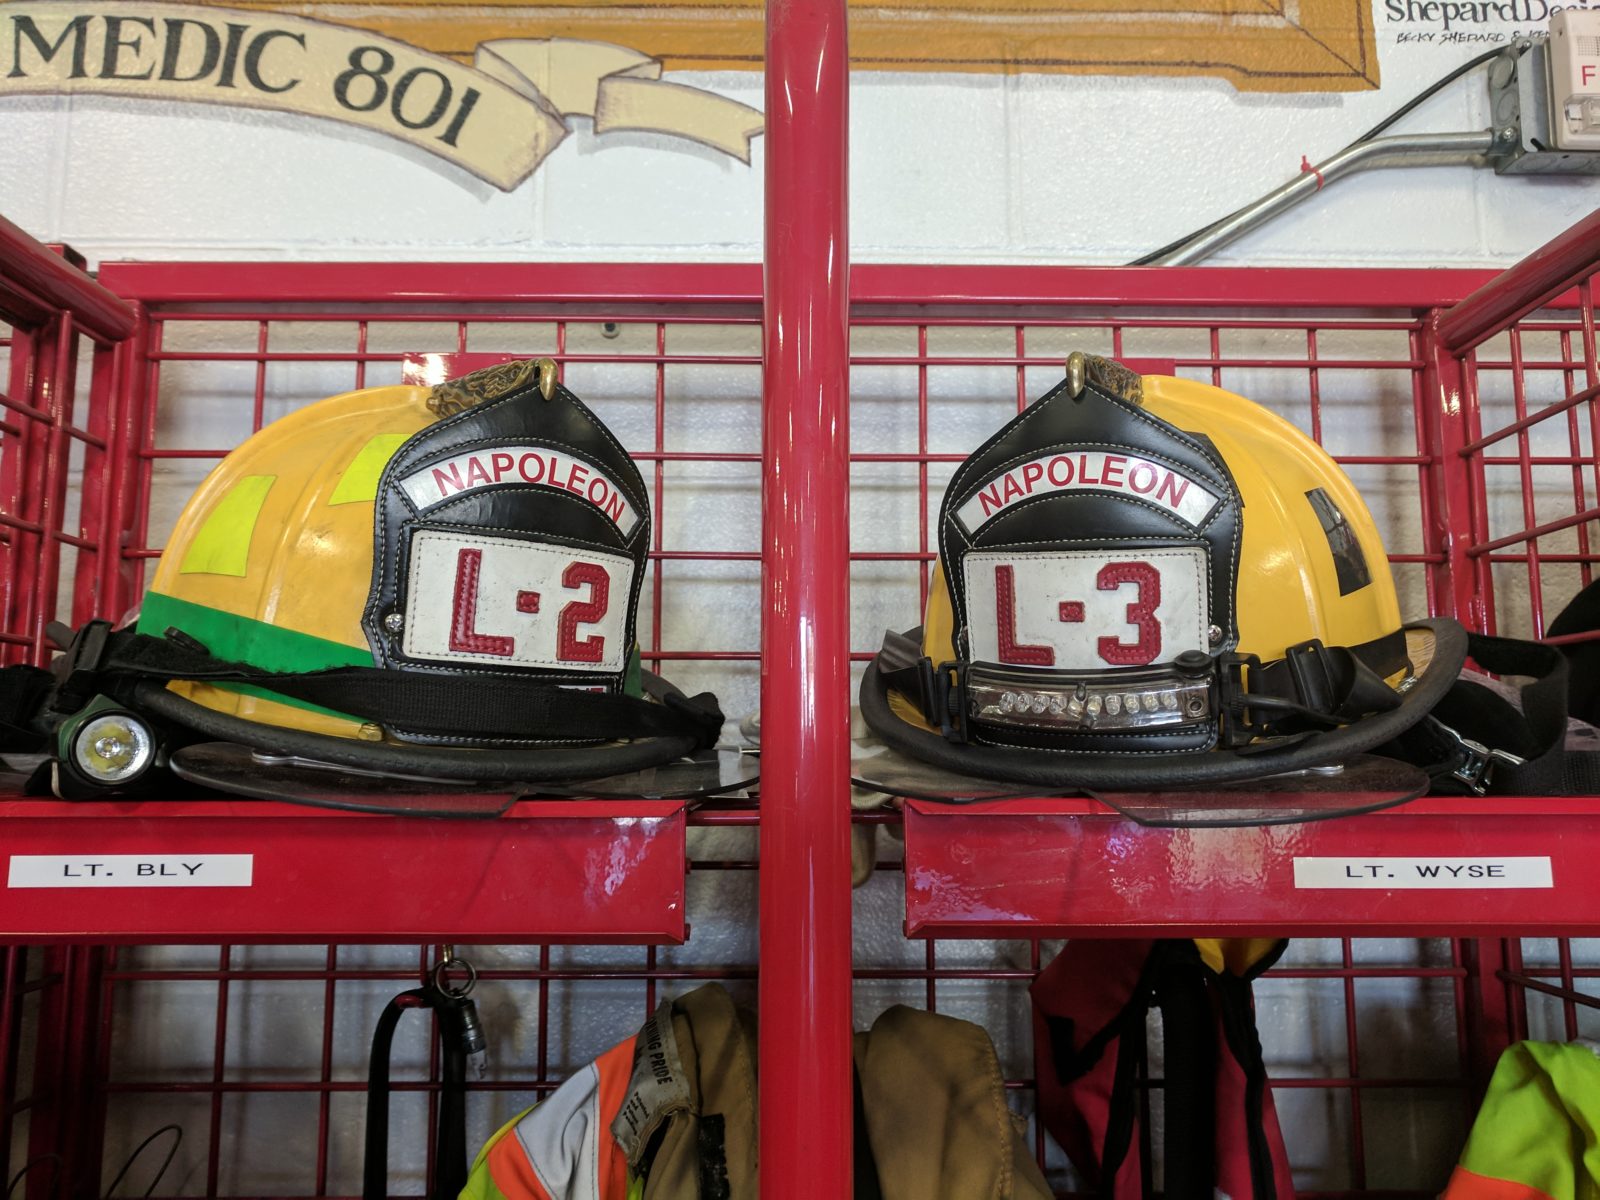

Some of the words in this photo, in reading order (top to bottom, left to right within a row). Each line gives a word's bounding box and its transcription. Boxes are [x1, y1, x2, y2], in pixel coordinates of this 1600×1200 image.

[1396, 32, 1436, 44] BECKY
[1438, 30, 1506, 45] SHEPARD
[7, 15, 306, 93] MEDIC
[333, 45, 482, 148] 801
[431, 452, 626, 524] NAPOLEON
[977, 454, 1190, 517] NAPOLEON
[449, 548, 611, 662] L-2
[994, 560, 1162, 666] L-3
[63, 863, 114, 877] LT.
[136, 862, 204, 876] BLY
[1346, 865, 1395, 878] LT.
[1415, 864, 1506, 878] WYSE
[649, 1052, 673, 1085] PRIDE
